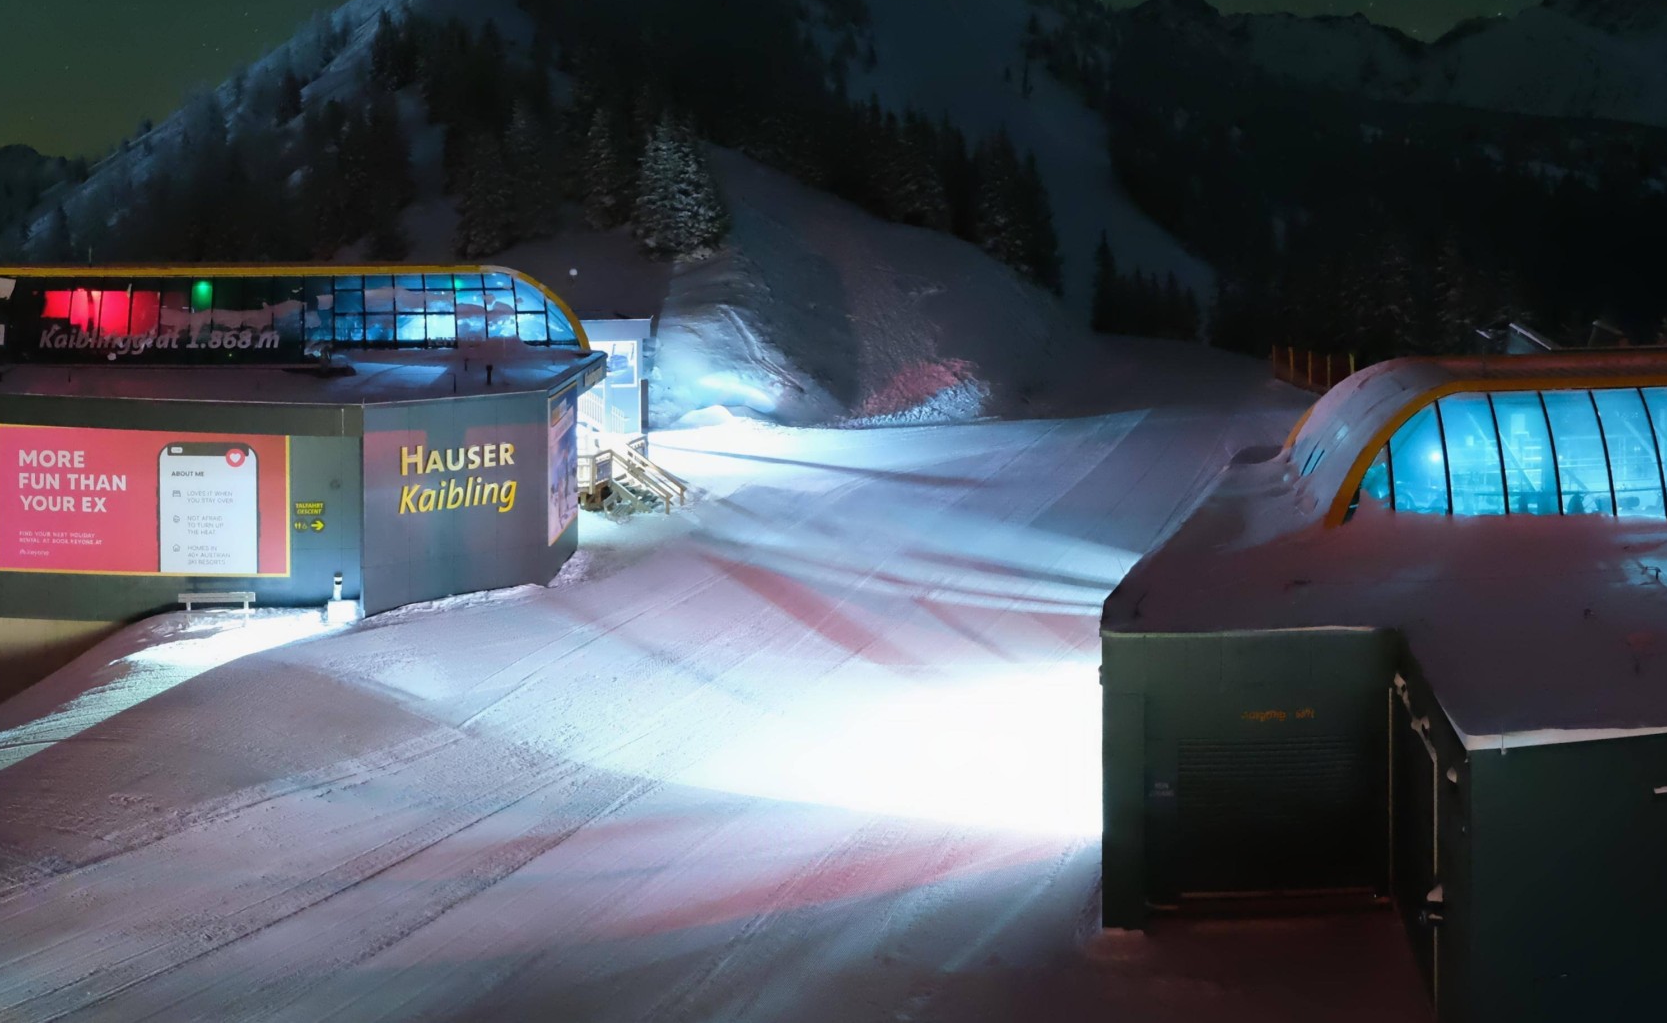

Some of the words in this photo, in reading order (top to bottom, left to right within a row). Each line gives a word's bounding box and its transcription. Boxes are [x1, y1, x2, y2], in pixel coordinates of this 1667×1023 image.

[39, 326, 179, 355] Kaiblinggrat
[186, 330, 252, 350] 1.868
[255, 333, 281, 349] m
[18, 449, 85, 468] MORE
[401, 442, 515, 476] HAUSER
[18, 473, 60, 490] FUN
[67, 473, 127, 491] THAN
[20, 495, 76, 512] YOUR
[82, 497, 107, 513] EX
[399, 477, 517, 514] Kaibling
